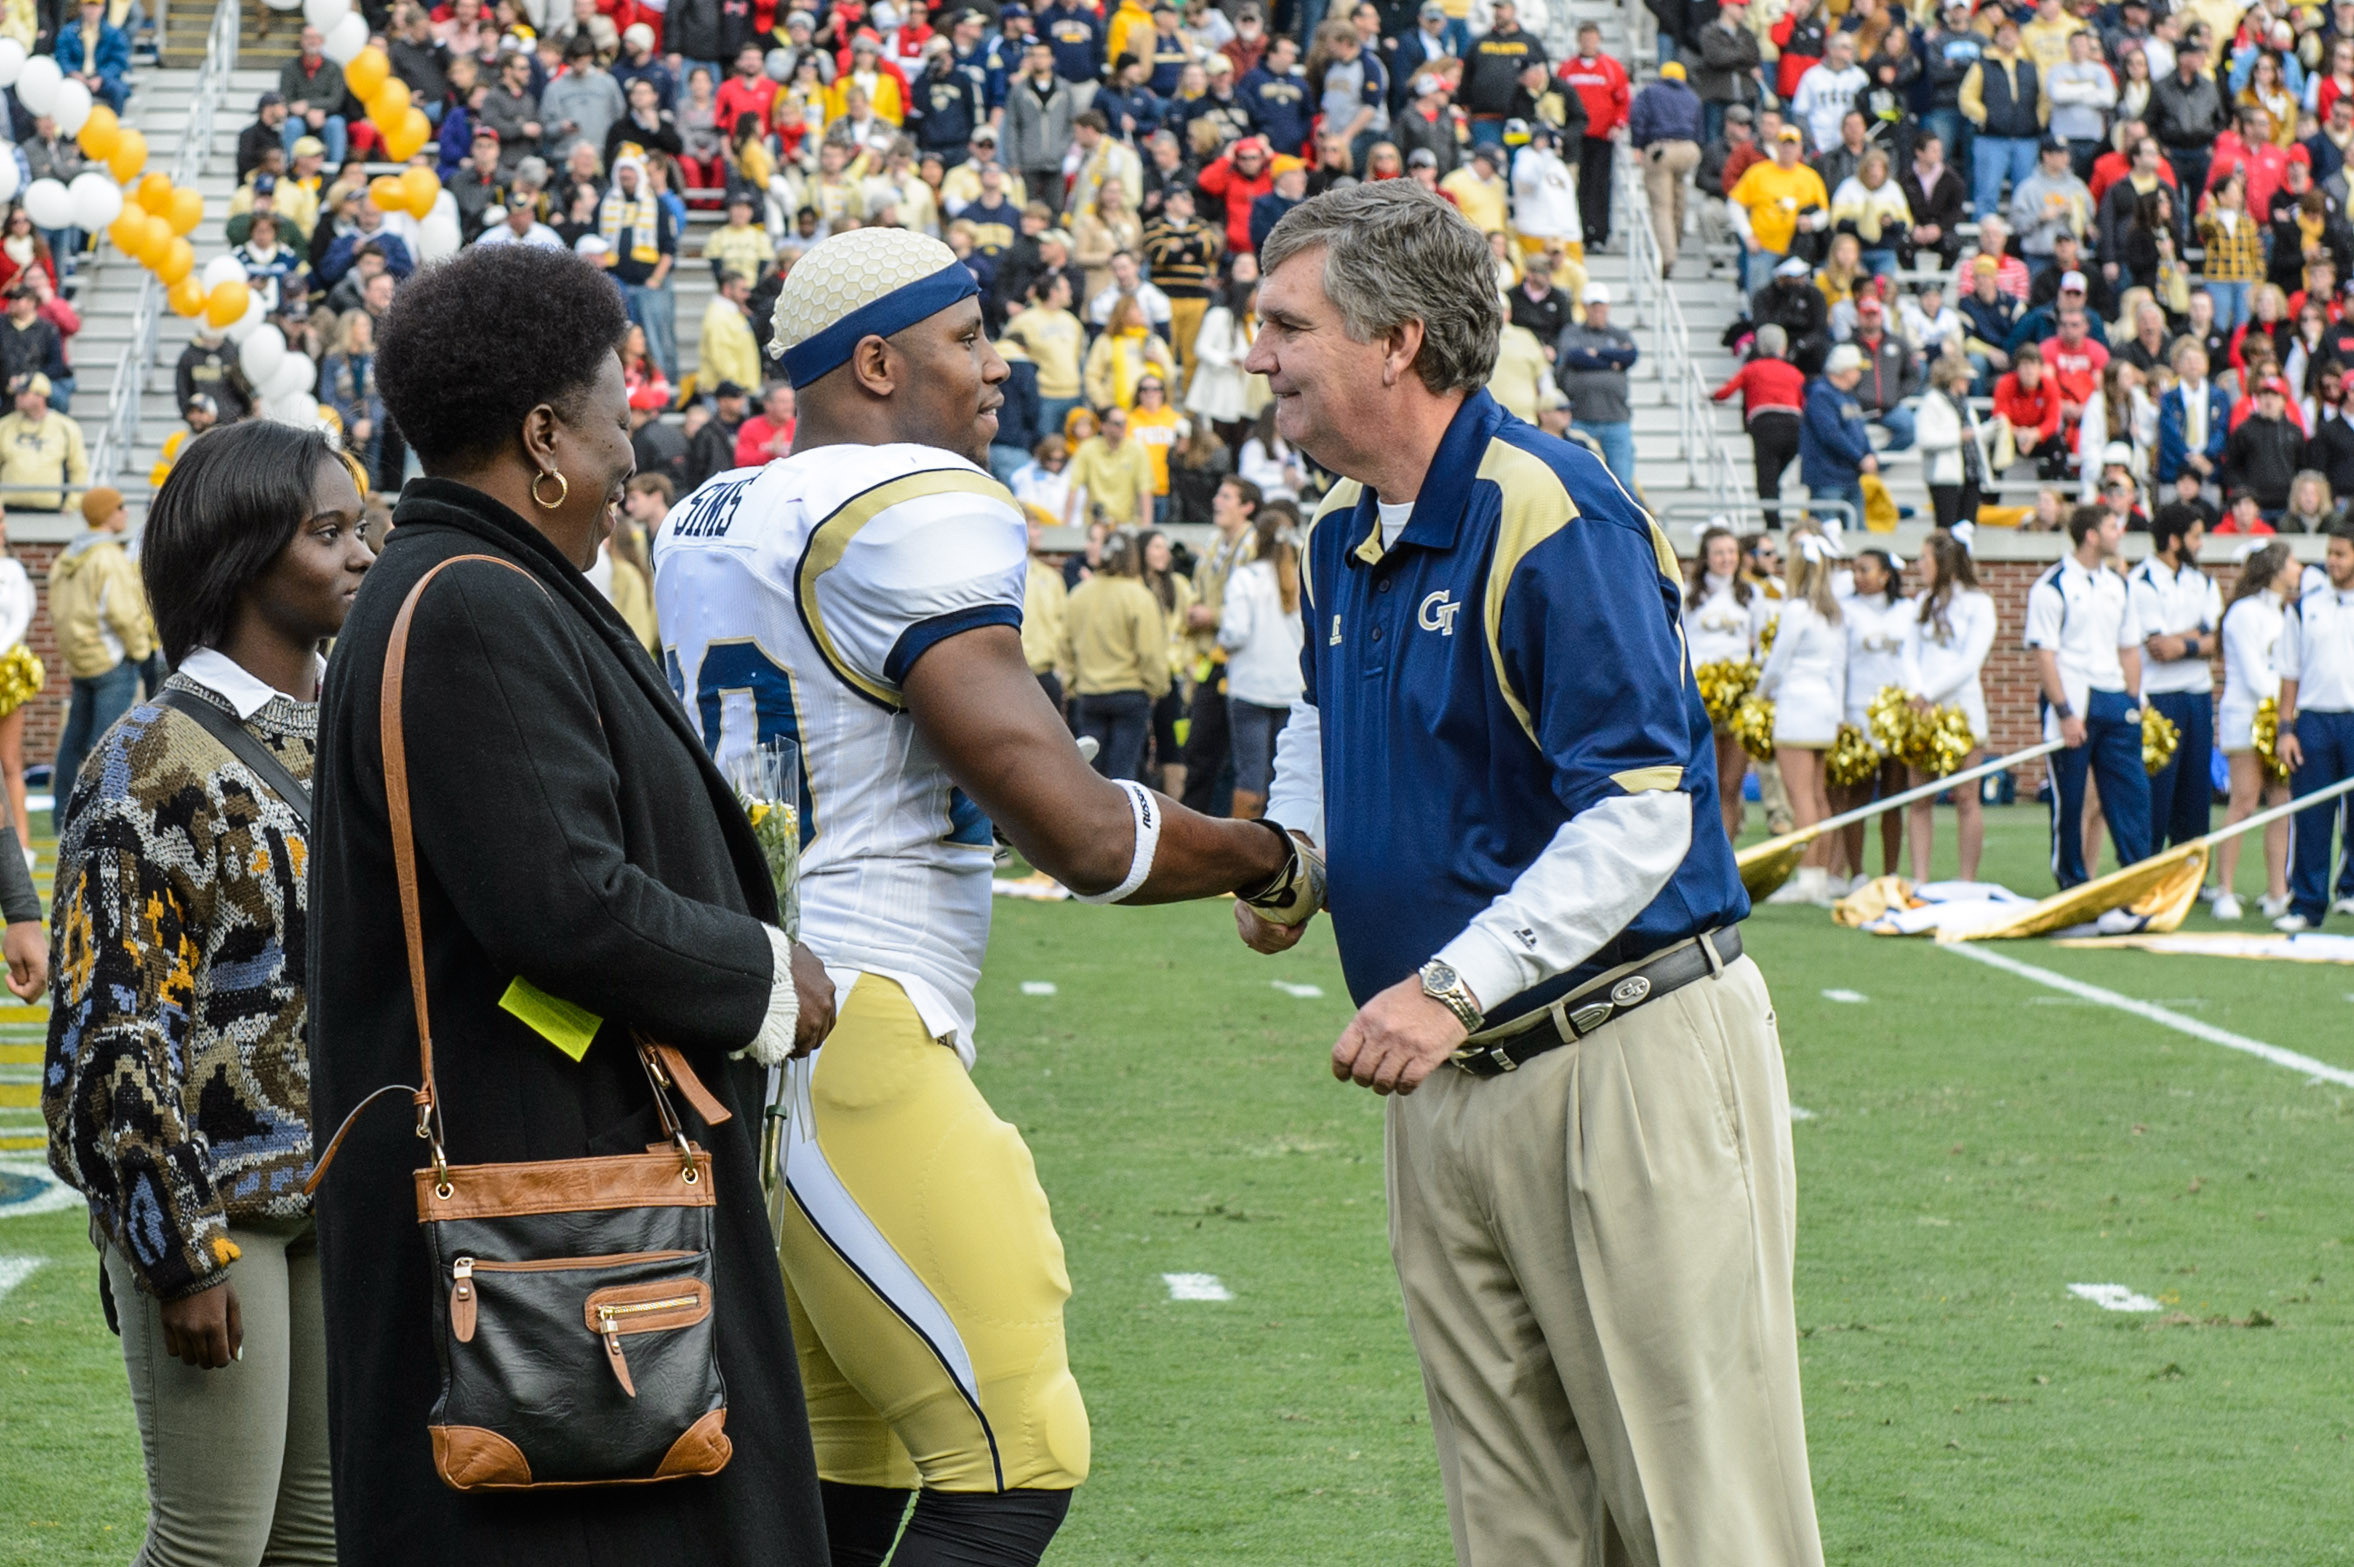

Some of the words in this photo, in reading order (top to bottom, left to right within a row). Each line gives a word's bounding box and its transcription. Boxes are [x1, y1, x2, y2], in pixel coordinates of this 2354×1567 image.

[673, 472, 763, 537] SIMS
[1418, 589, 1461, 636] GT
[665, 634, 822, 860] 0
